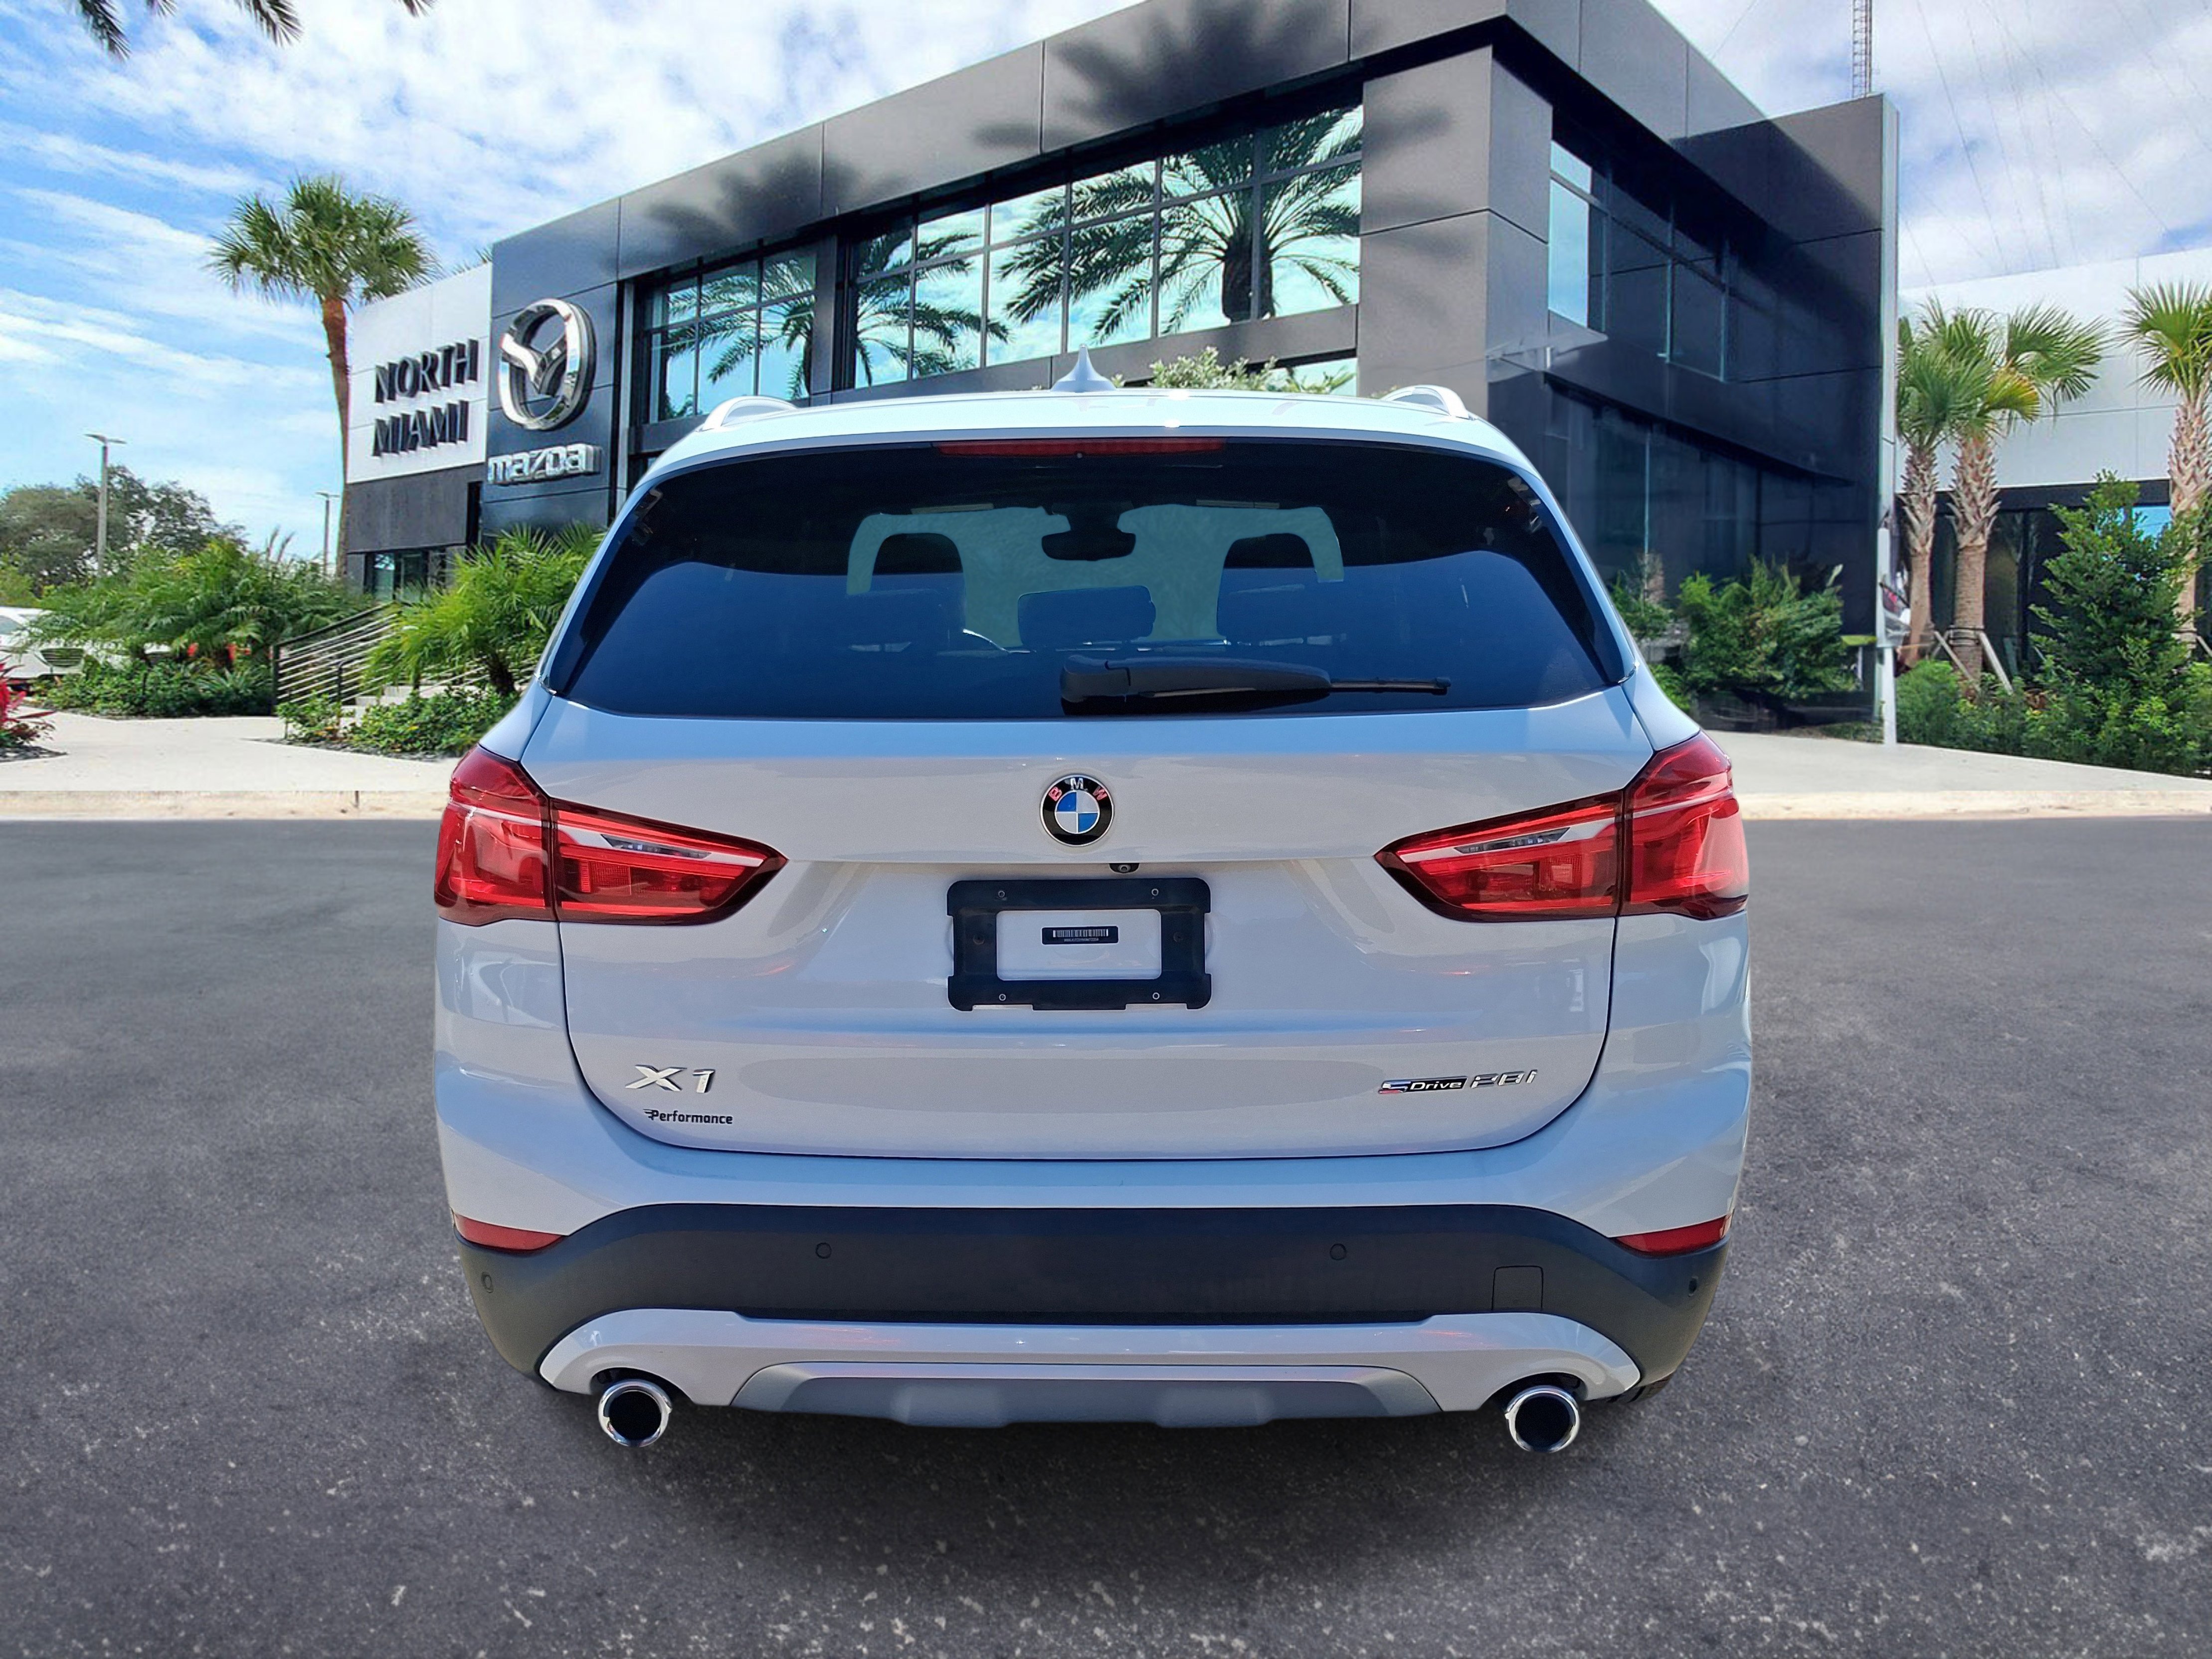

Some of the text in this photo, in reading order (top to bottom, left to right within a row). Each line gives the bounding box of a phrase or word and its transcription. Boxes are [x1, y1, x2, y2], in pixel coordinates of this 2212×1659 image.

[374, 339, 479, 403] NORTH
[372, 400, 469, 456] MIAMI
[488, 443, 600, 485] mazda
[1048, 777, 1108, 801] BMW
[625, 1064, 716, 1093] X1
[643, 1108, 733, 1124] Performance
